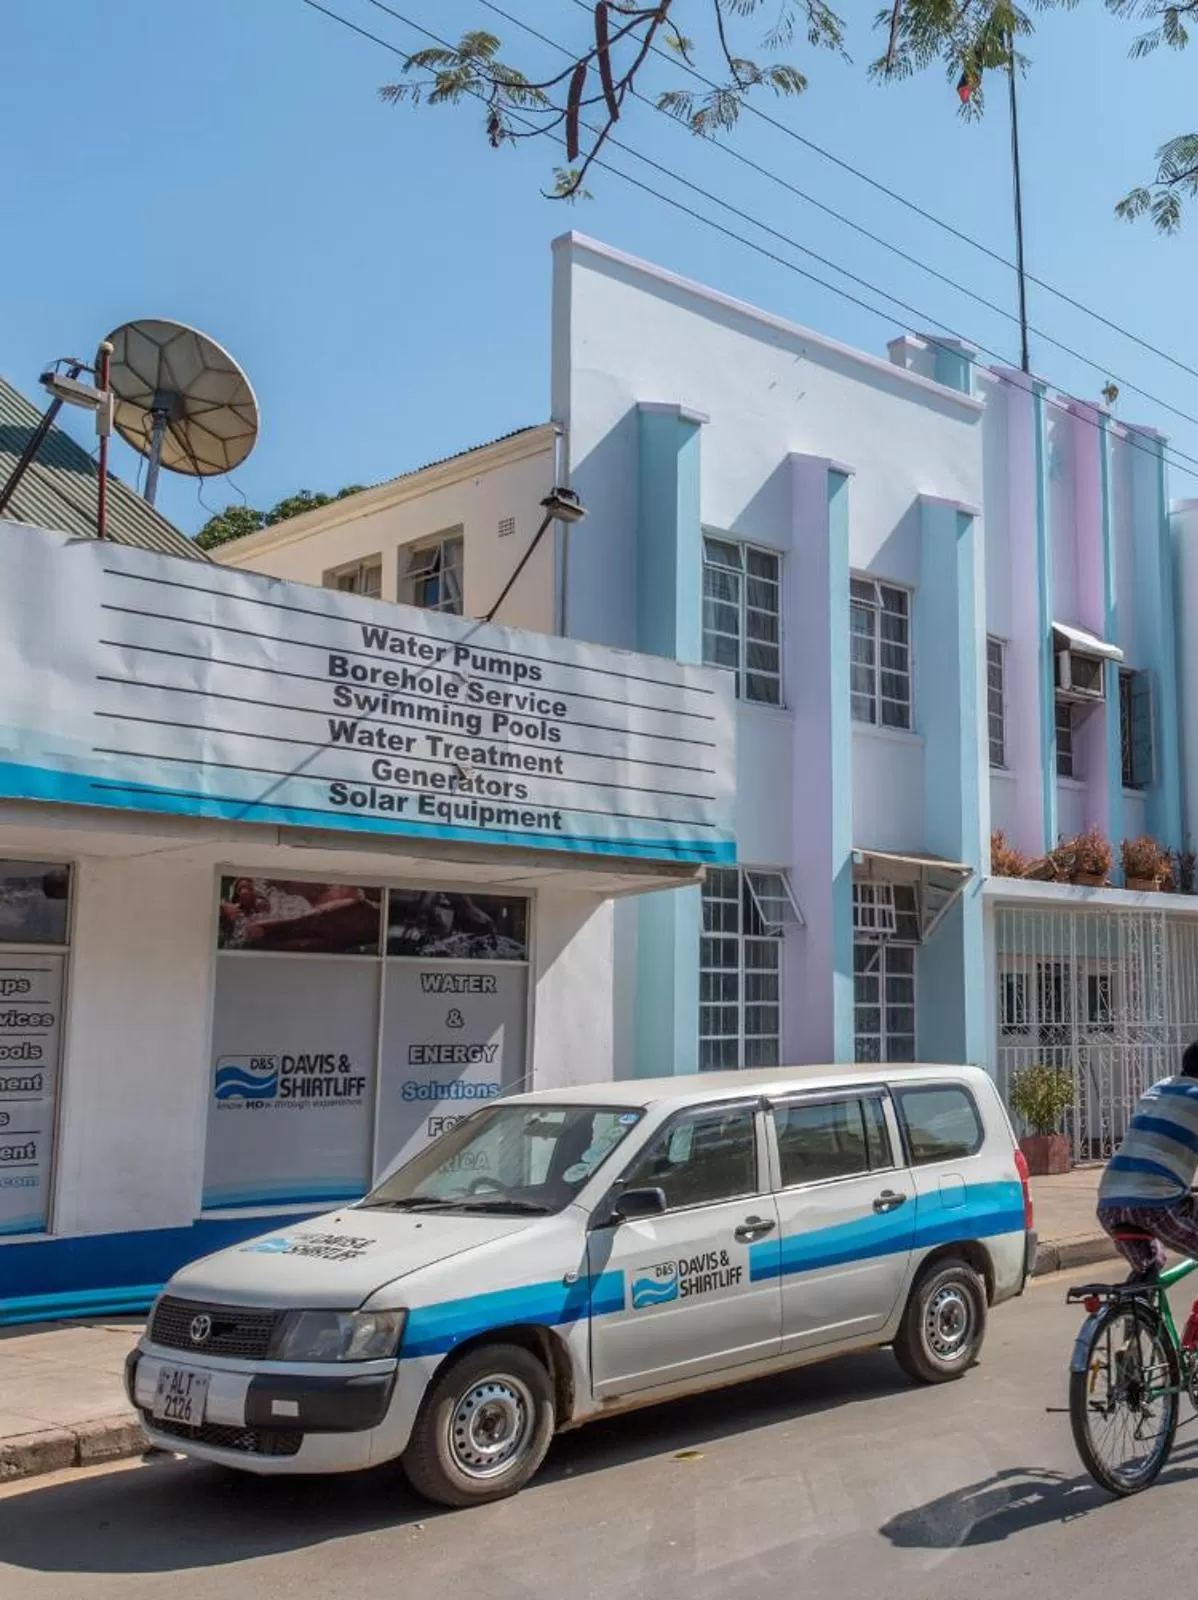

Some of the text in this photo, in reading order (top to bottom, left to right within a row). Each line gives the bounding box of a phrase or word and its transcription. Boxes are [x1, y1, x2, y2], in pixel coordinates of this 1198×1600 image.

[361, 626, 543, 682] Water Pumps
[328, 654, 567, 717] Borehole Service
[332, 685, 562, 743] Swimming Pools
[328, 719, 564, 775] Water Treatment
[372, 759, 528, 799] Generators
[329, 782, 563, 831] Solar Equipment
[420, 973, 498, 994] WATER
[445, 1008, 464, 1028] &
[250, 1058, 274, 1070] D&S
[281, 1053, 351, 1075] DAVIS &
[408, 1044, 499, 1065] ENERGY
[280, 1077, 366, 1098] SHIRTLIFF
[402, 1080, 501, 1101] Solutions
[655, 1263, 674, 1278] D&S
[678, 1249, 730, 1277] DAVIS &
[679, 1266, 743, 1298] SHIRTLIFF
